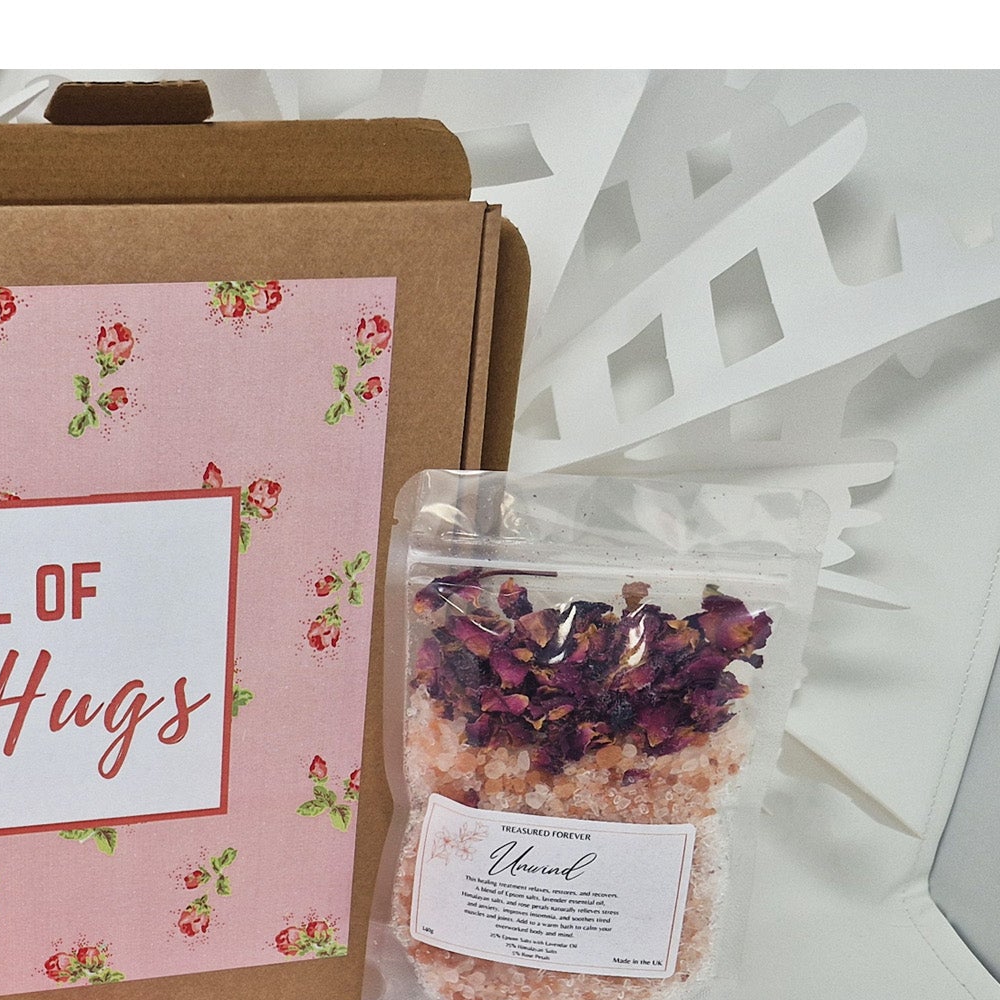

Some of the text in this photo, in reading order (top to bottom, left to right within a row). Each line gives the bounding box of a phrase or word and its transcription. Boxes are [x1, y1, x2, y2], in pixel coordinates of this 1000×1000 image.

[34, 561, 102, 622] OF
[501, 825, 592, 841] TREASURED FOREVER
[488, 840, 598, 881] Unwind
[477, 878, 497, 887] healing
[499, 882, 527, 891] treatment
[461, 891, 490, 901] Himalayan
[531, 903, 549, 911] petals
[577, 907, 600, 915] relieves
[481, 887, 496, 895] blend
[505, 890, 525, 898] Epsom
[542, 895, 567, 903] lavender
[568, 898, 595, 906] essential
[529, 927, 544, 935] body
